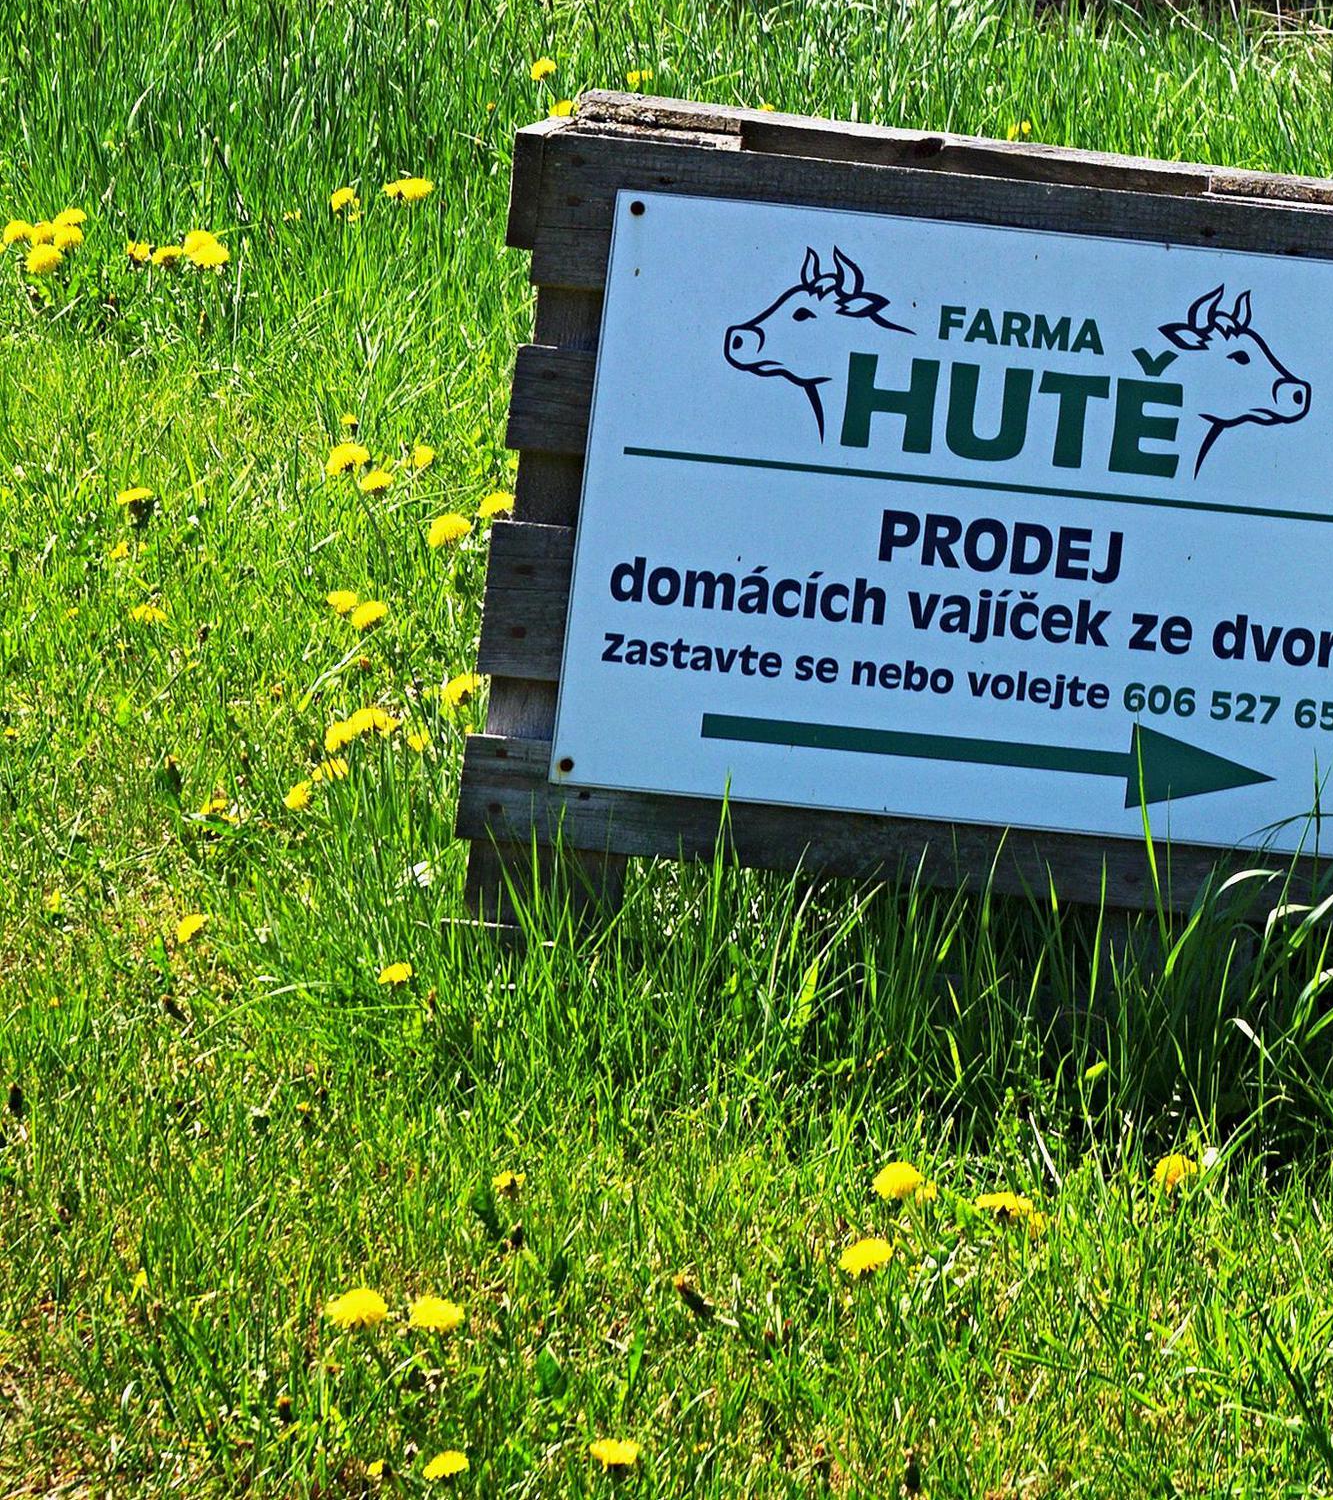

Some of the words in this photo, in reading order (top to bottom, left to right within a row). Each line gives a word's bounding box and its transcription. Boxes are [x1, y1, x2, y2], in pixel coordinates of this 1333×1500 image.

[939, 305, 1104, 355] FARMA
[840, 348, 1183, 478] HUTĚ
[879, 510, 1123, 584] PRODEJ
[610, 557, 886, 625] domácích
[908, 589, 1111, 647] vajíček
[1129, 613, 1192, 654] ze
[602, 633, 782, 677] Zastavte
[795, 655, 838, 683] se
[852, 660, 953, 694] nebo
[968, 671, 1109, 709] volejte
[1124, 683, 1195, 717] 606
[1210, 691, 1280, 724] 527
